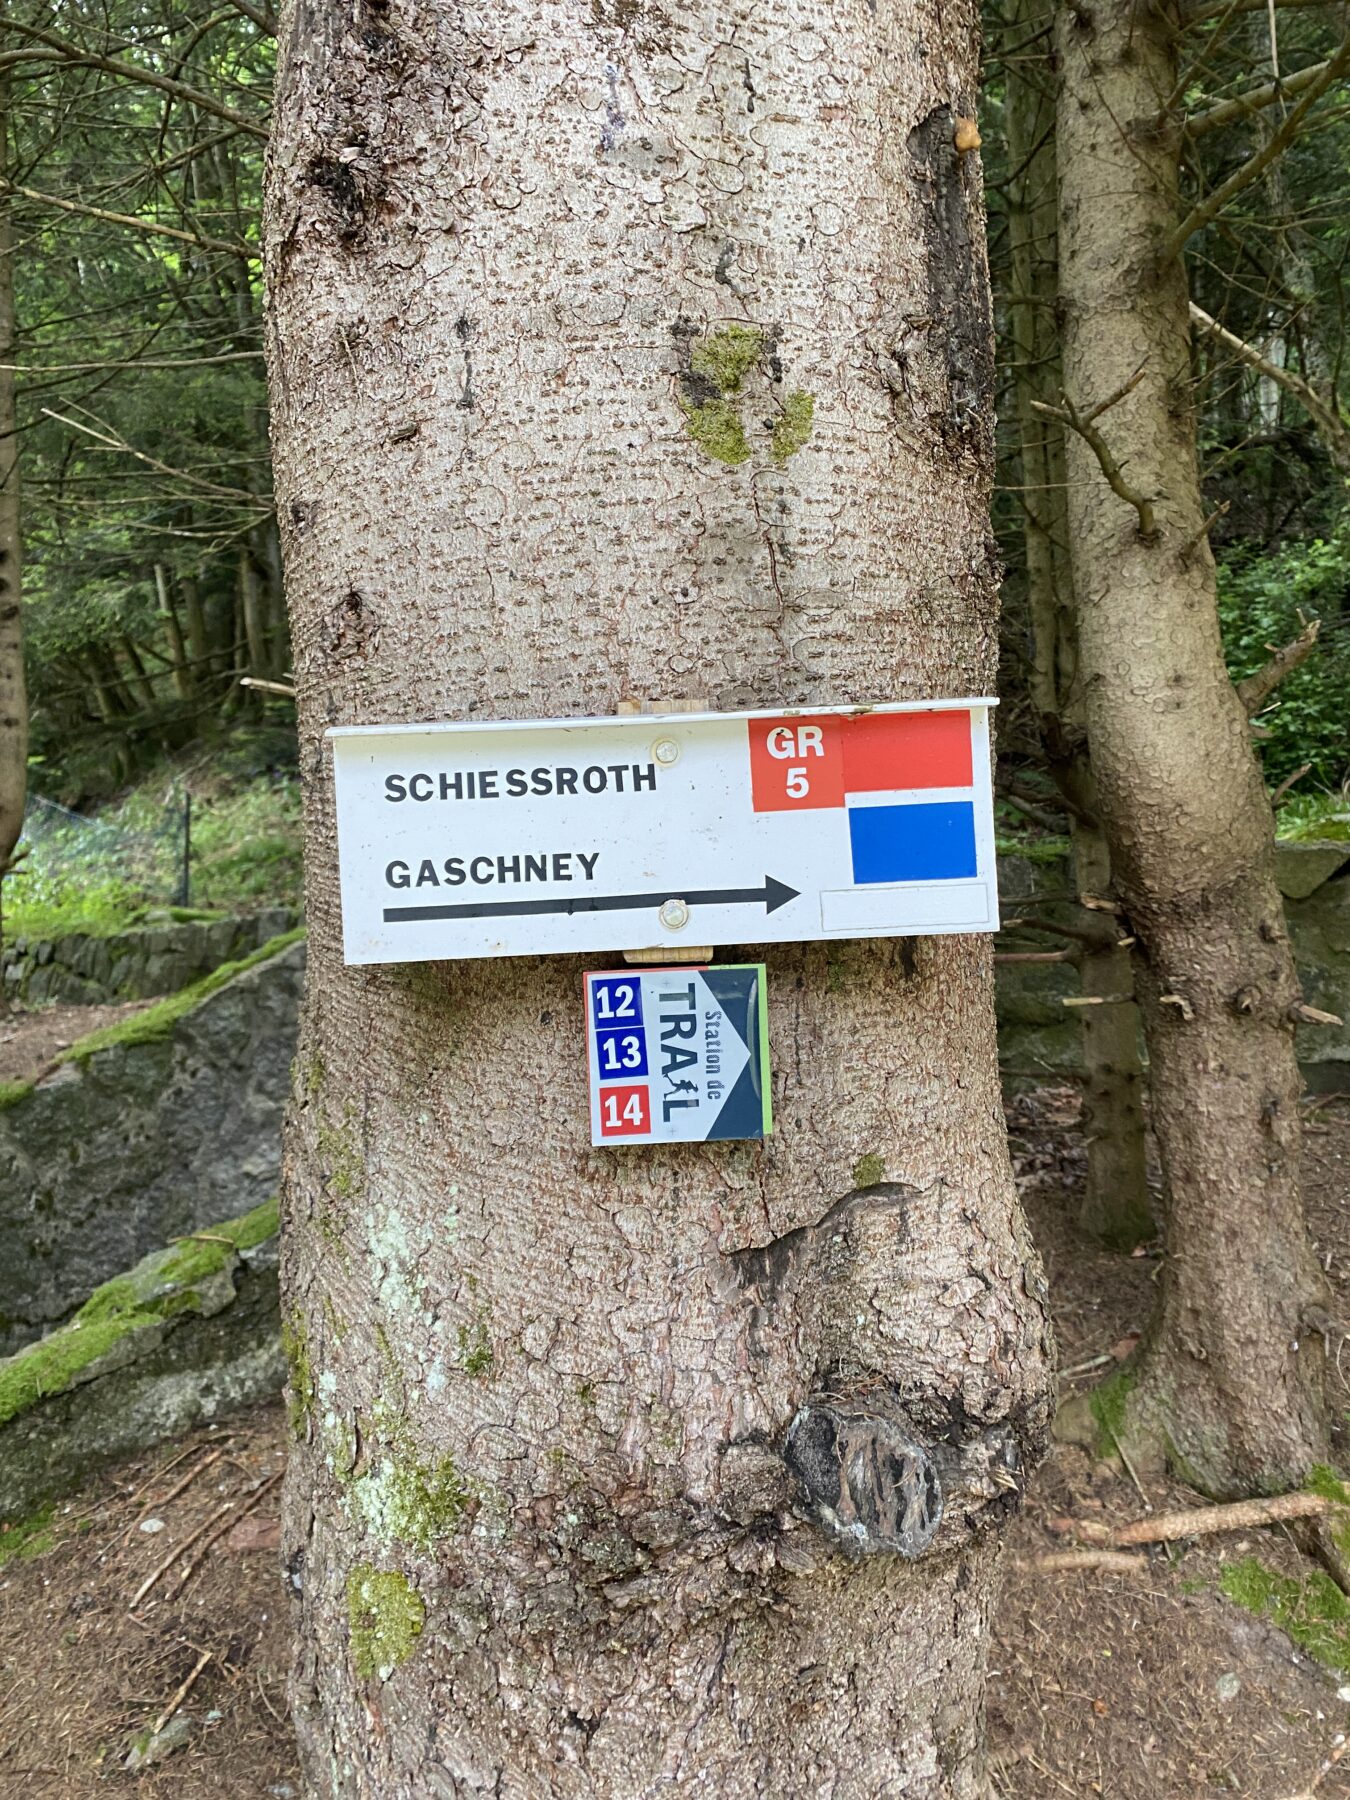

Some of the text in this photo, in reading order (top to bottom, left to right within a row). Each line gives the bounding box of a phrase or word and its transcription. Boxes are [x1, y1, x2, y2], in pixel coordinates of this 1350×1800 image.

[766, 725, 825, 760] GR
[384, 763, 657, 802] SCHIESSROTH
[785, 767, 810, 799] 5
[385, 852, 600, 888] GASCHNEY
[596, 984, 636, 1019] 12
[602, 1035, 642, 1070] 13
[704, 1010, 725, 1100] Station de
[604, 1093, 644, 1128] 14
